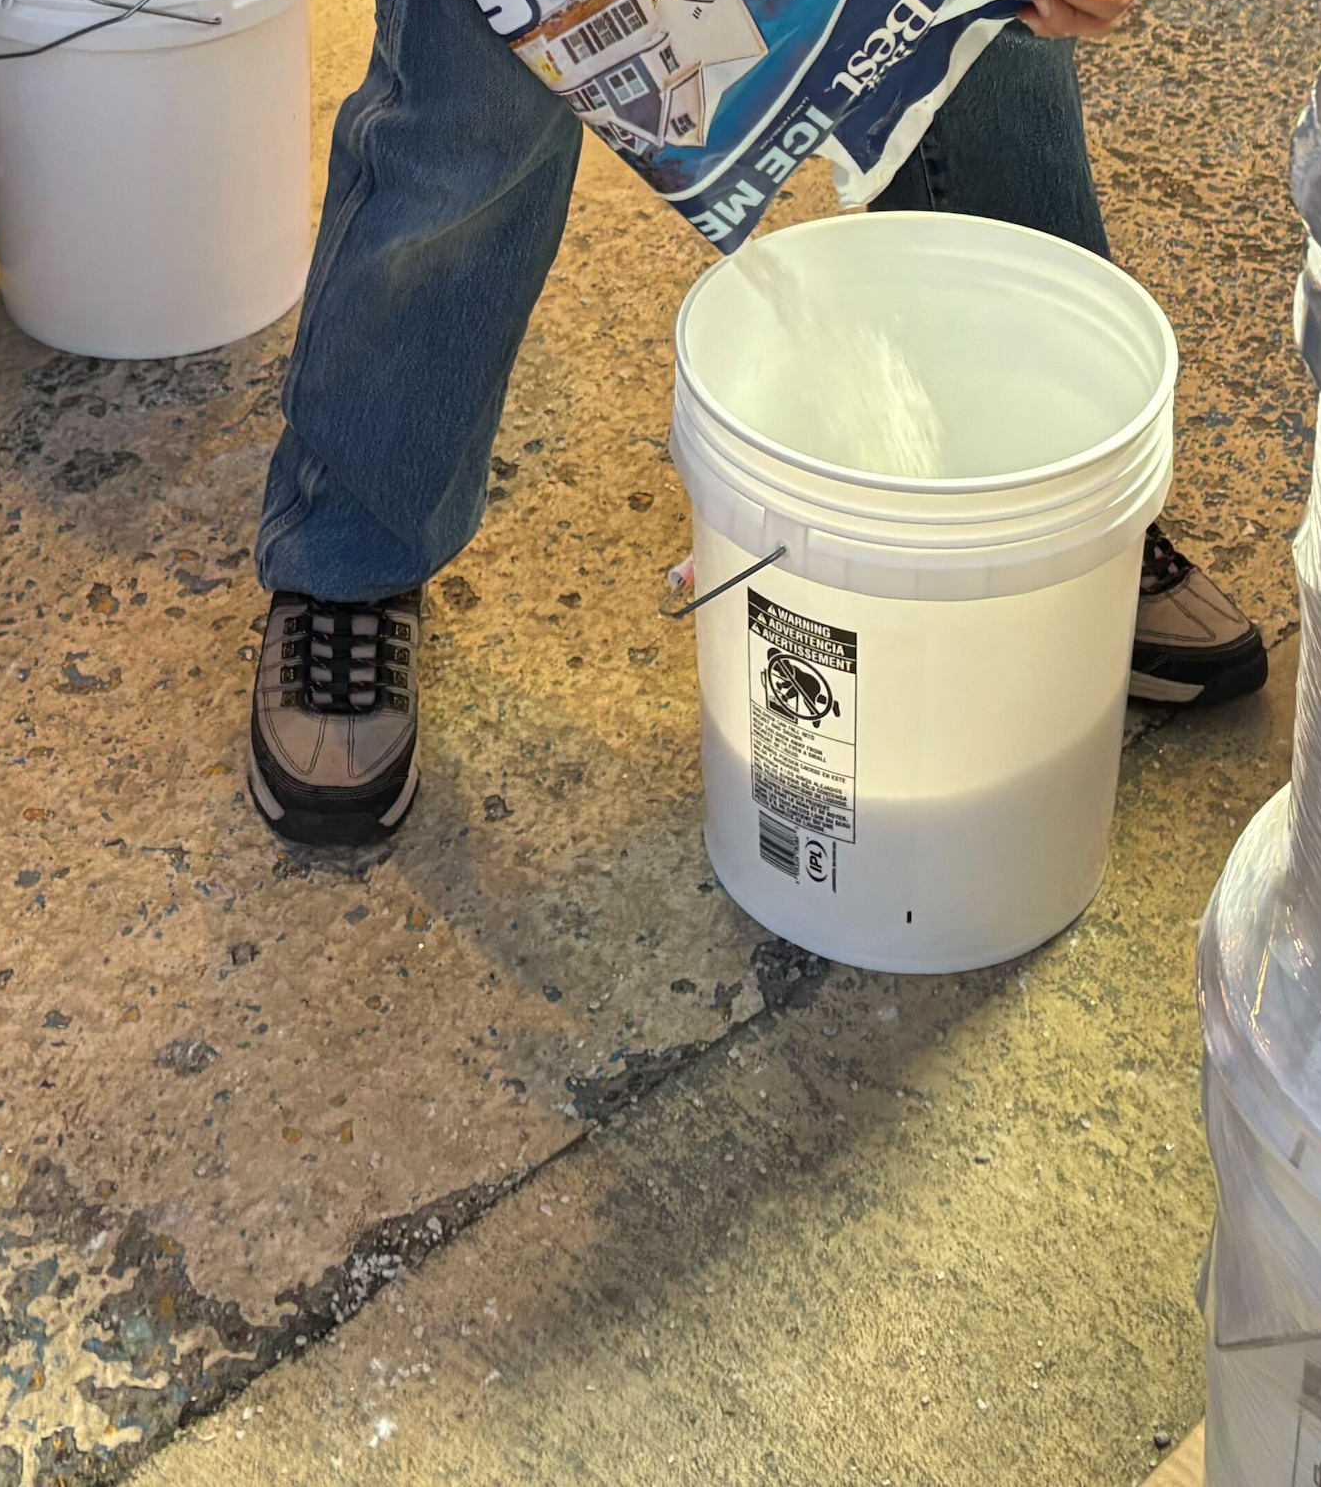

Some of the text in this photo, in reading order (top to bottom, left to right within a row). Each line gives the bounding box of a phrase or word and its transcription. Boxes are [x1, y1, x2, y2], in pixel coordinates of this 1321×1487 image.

[753, 104, 835, 185] ICE
[768, 617, 846, 657] ADVERTENCIA
[777, 607, 832, 639] WARNING
[762, 628, 853, 672] AVERTISSEMENT
